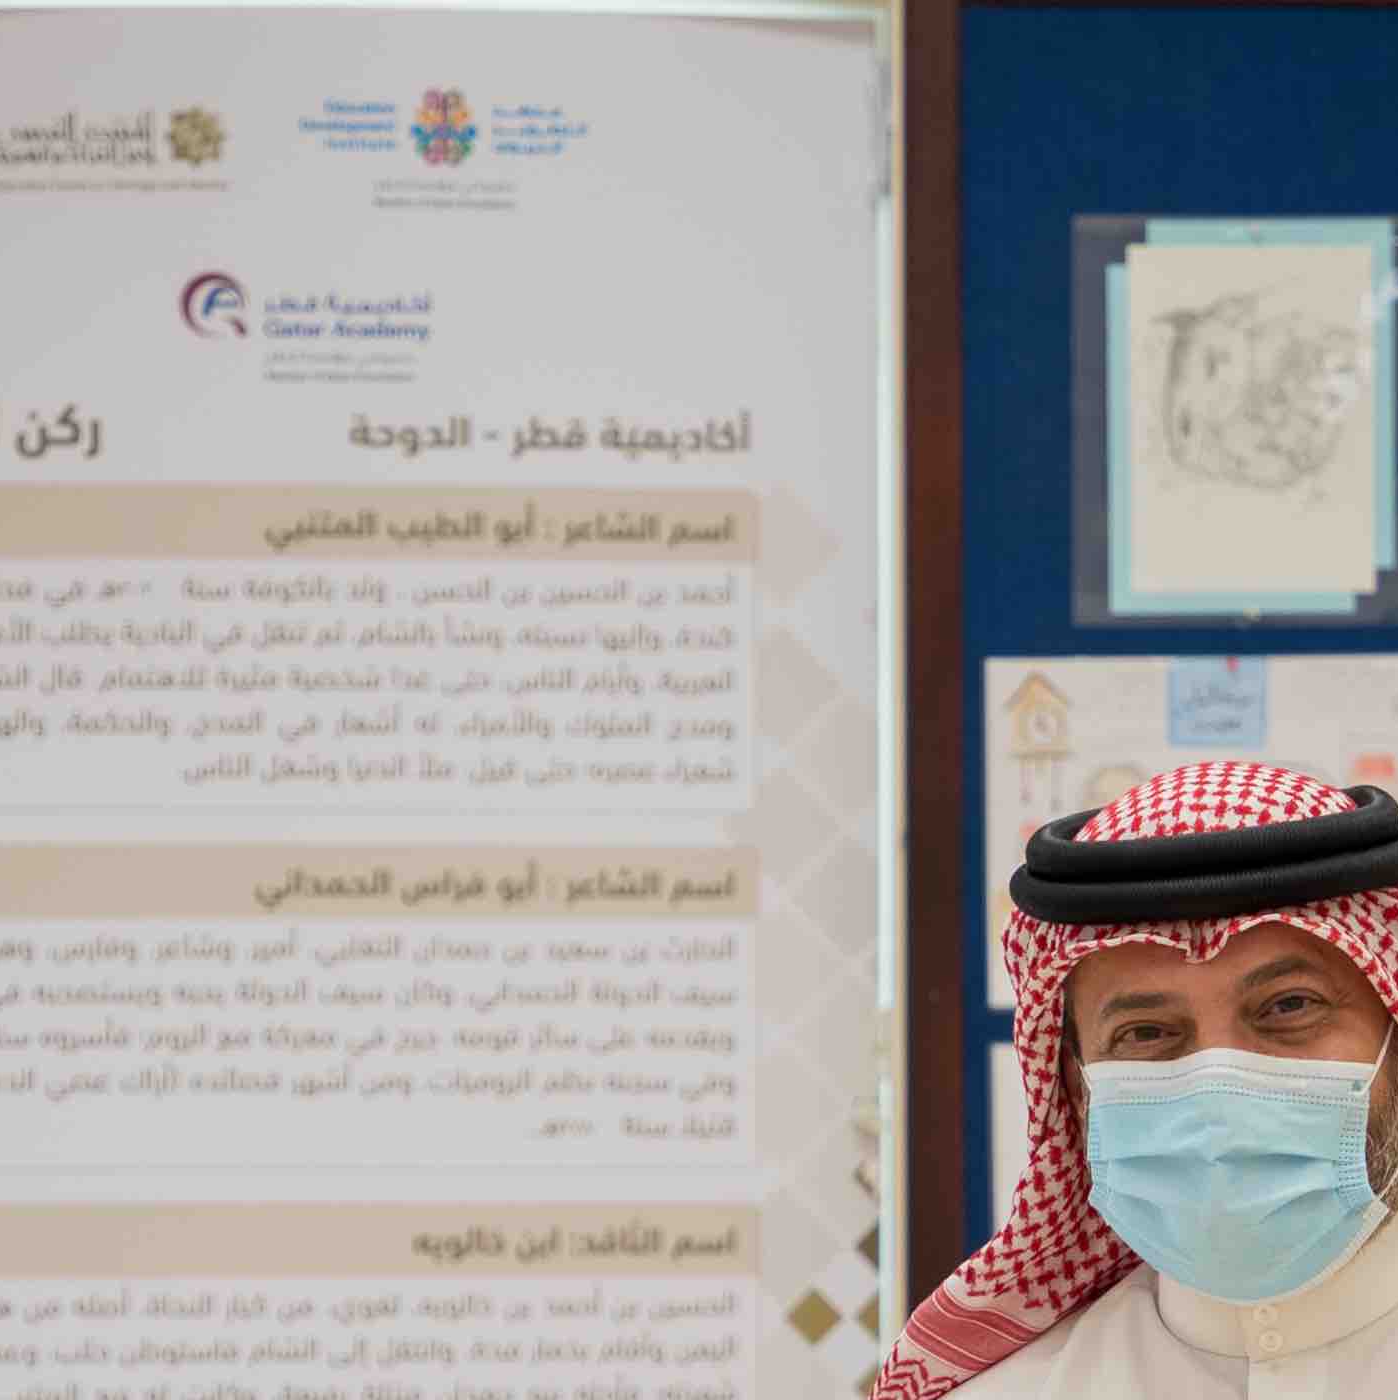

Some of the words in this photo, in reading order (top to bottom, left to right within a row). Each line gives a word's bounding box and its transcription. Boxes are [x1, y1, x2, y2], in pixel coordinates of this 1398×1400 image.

[14, 402, 104, 459] ركن
[349, 412, 471, 457] الدوحة
[511, 416, 587, 459] قطر
[599, 409, 751, 460] أكاديمية
[263, 510, 378, 553] المتنبي
[386, 508, 486, 548] الطيب
[494, 497, 537, 545] أبو
[668, 512, 735, 546] اسم
[496, 858, 539, 905] أبو
[668, 868, 736, 905] اسم
